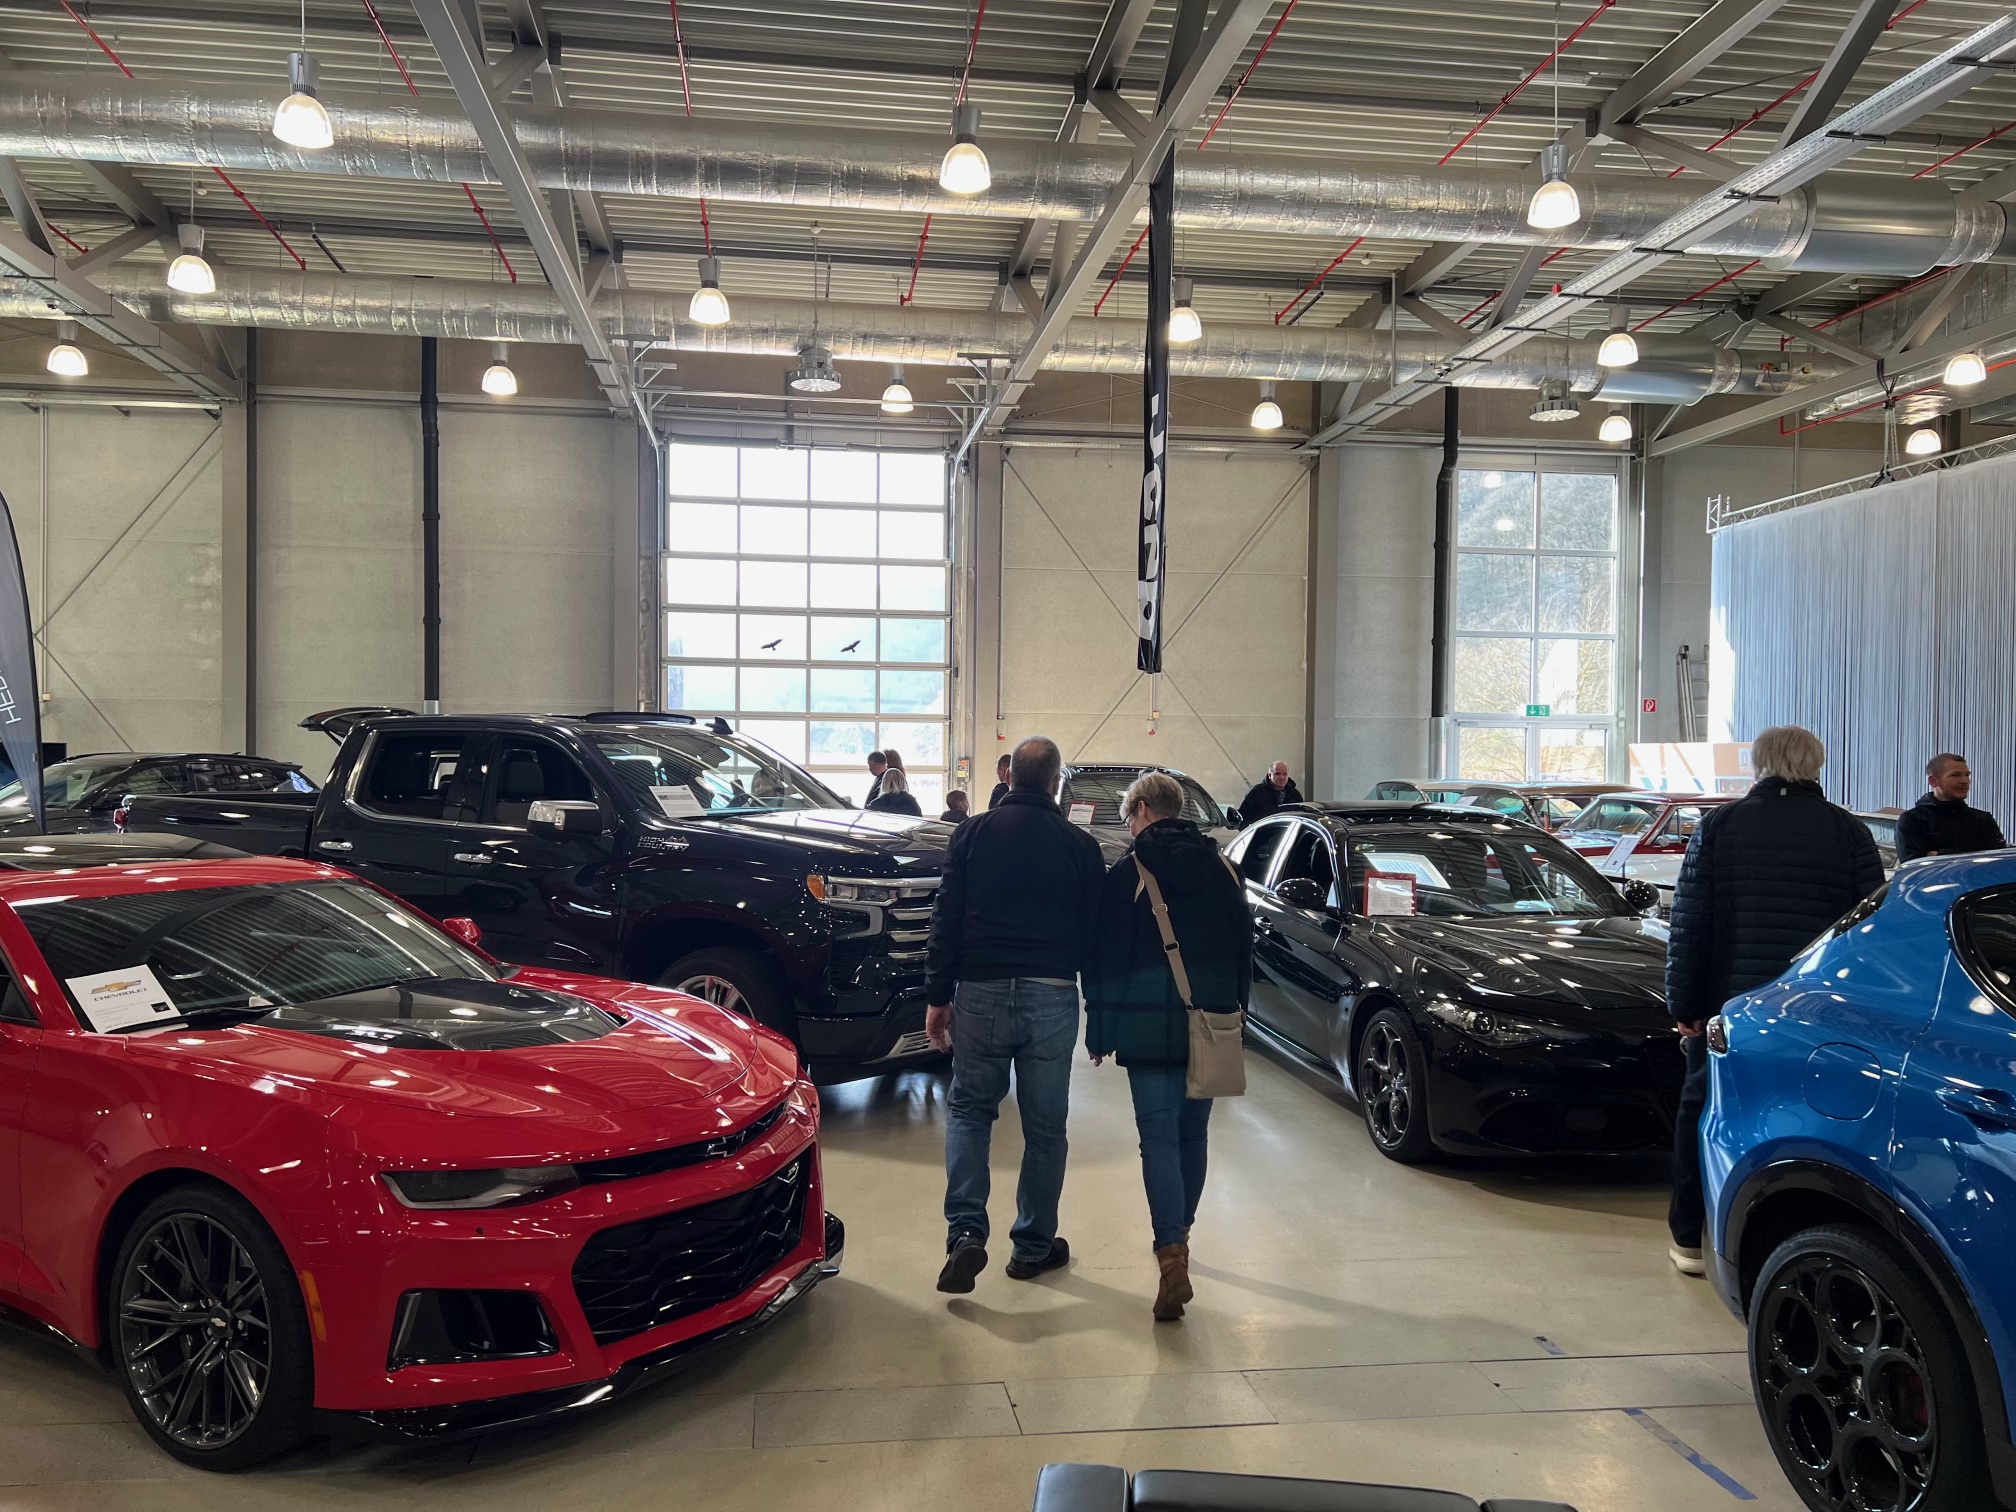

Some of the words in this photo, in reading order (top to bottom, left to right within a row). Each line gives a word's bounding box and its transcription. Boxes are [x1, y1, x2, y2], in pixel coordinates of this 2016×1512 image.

[639, 835, 665, 843] HIGH
[637, 842, 688, 852] COUNTRY
[93, 988, 147, 1002] CHEVROLET
